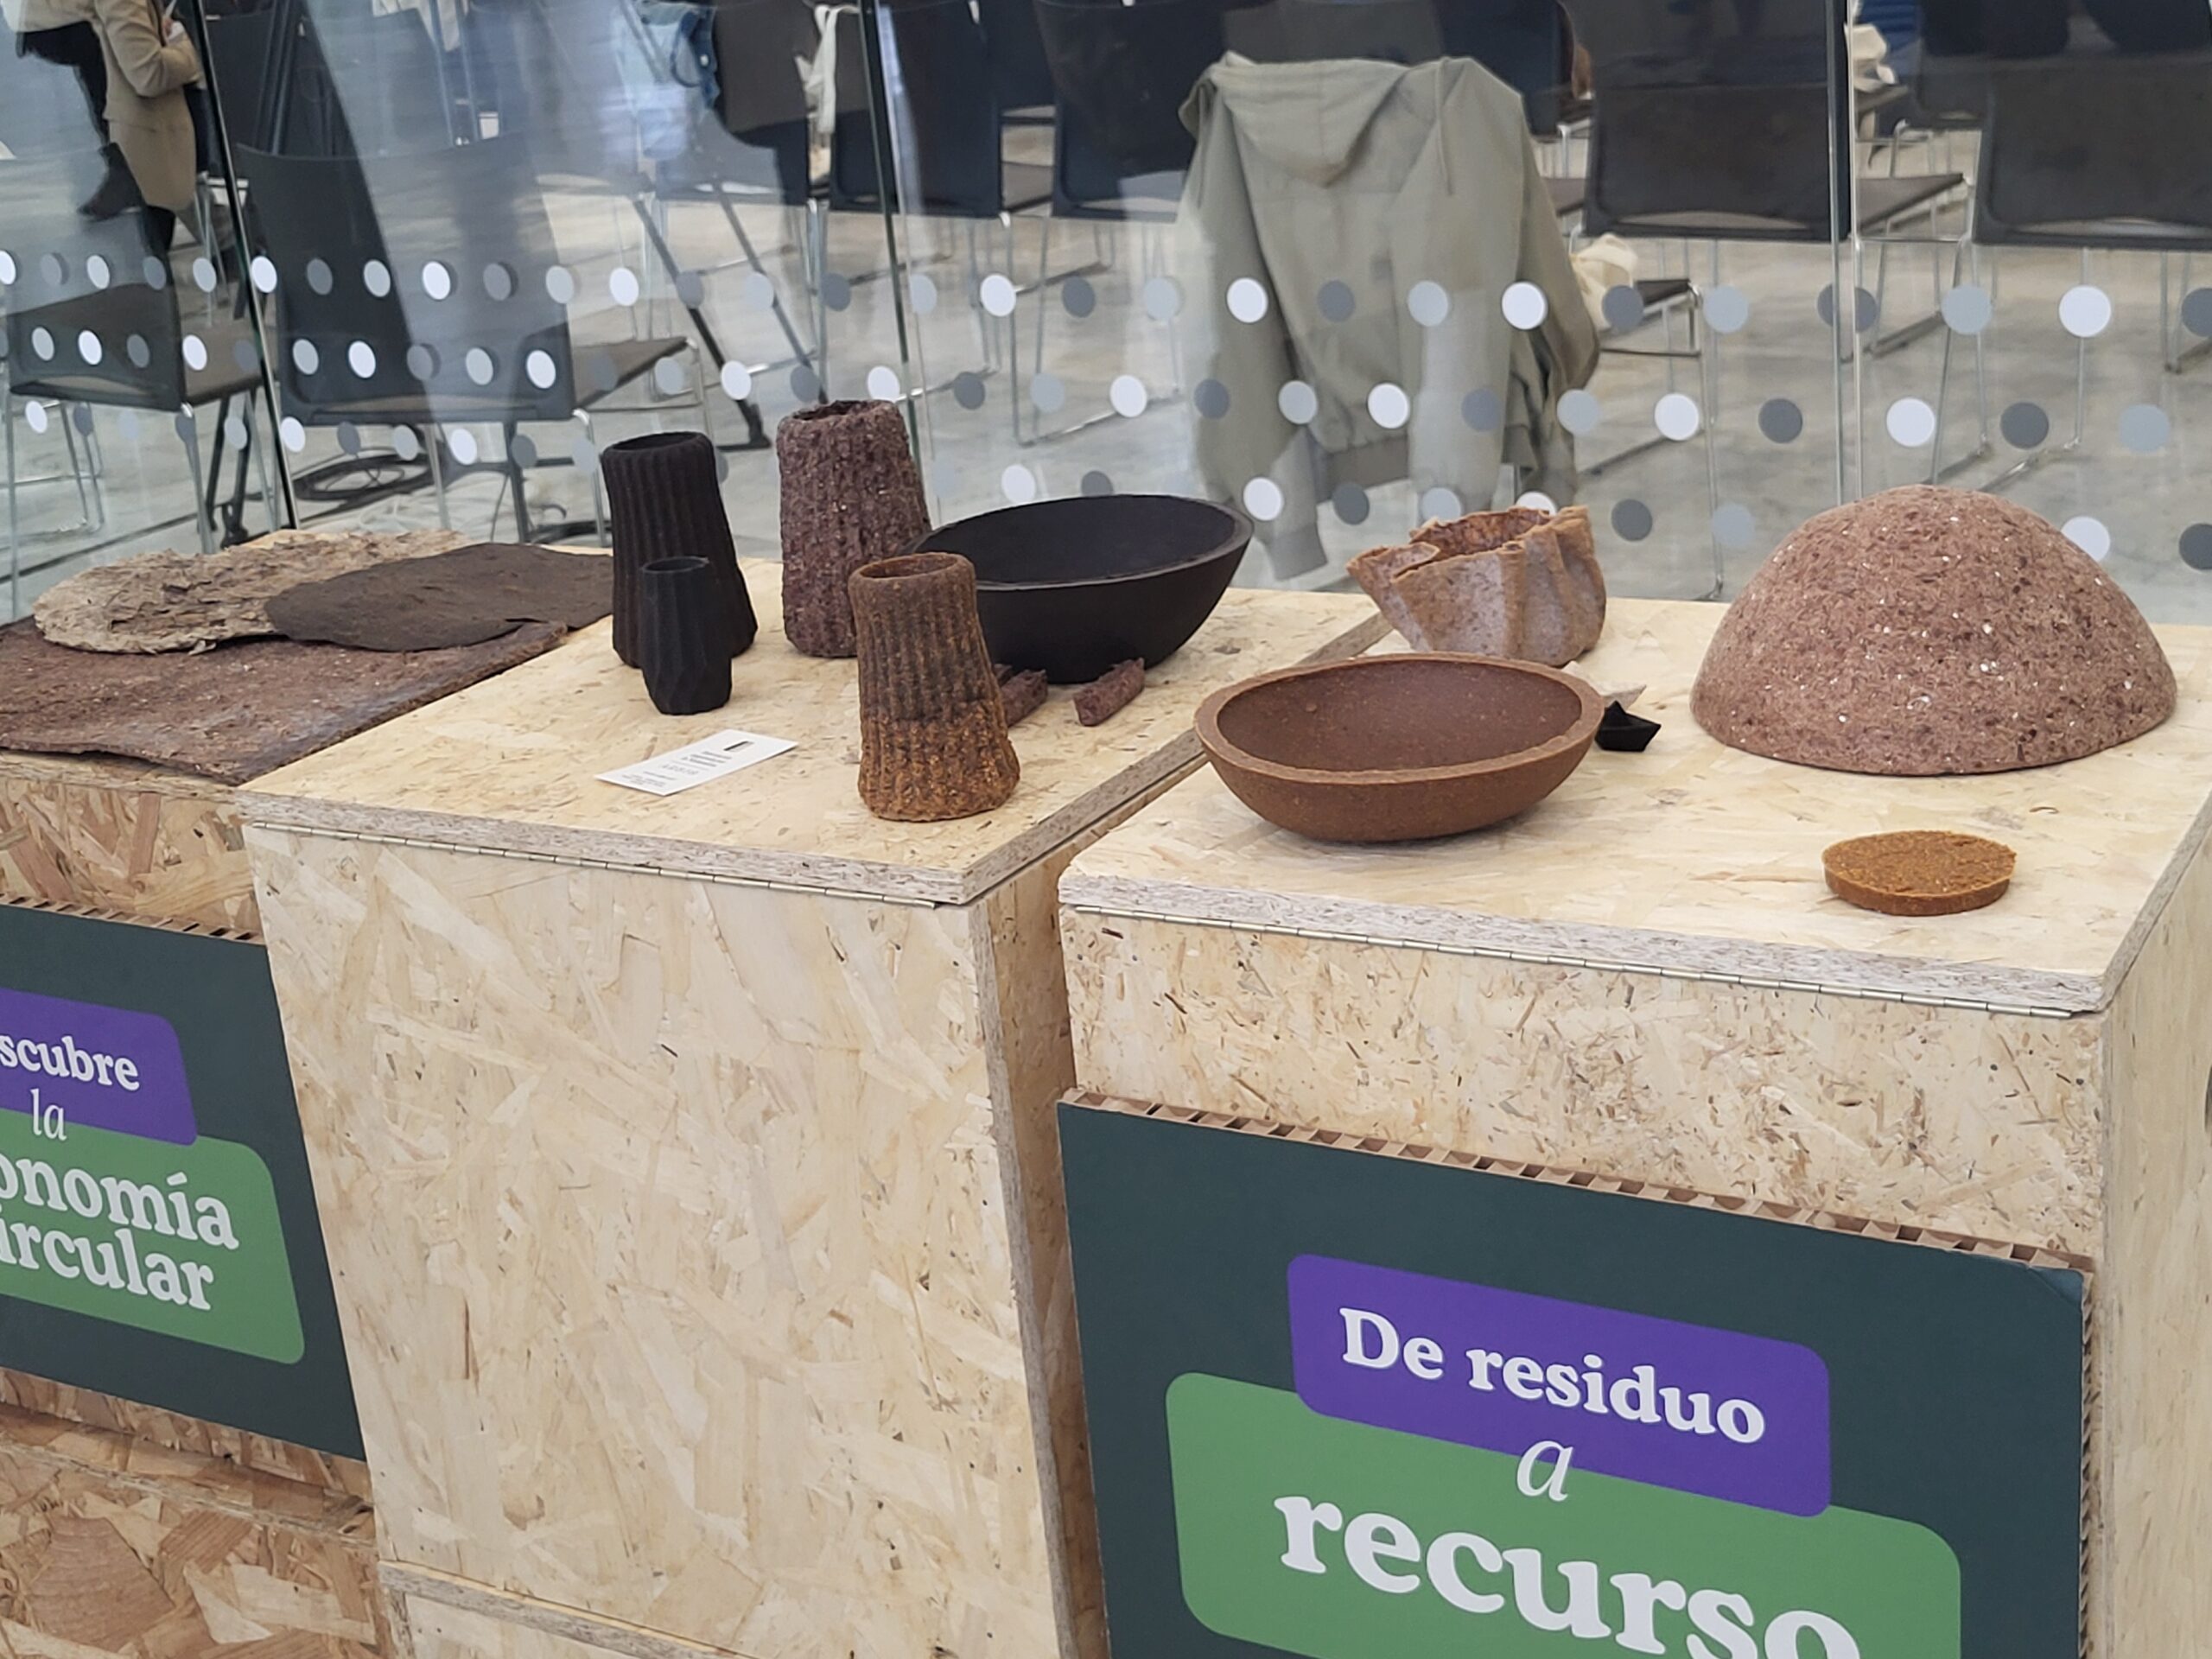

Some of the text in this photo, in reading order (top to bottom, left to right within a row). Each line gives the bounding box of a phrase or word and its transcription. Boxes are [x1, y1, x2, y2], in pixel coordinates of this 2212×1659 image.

[29, 1088, 67, 1141] la
[1338, 1306, 1765, 1444] De residuo
[1516, 1440, 1574, 1503] a
[1273, 1495, 1861, 1659] recurso
